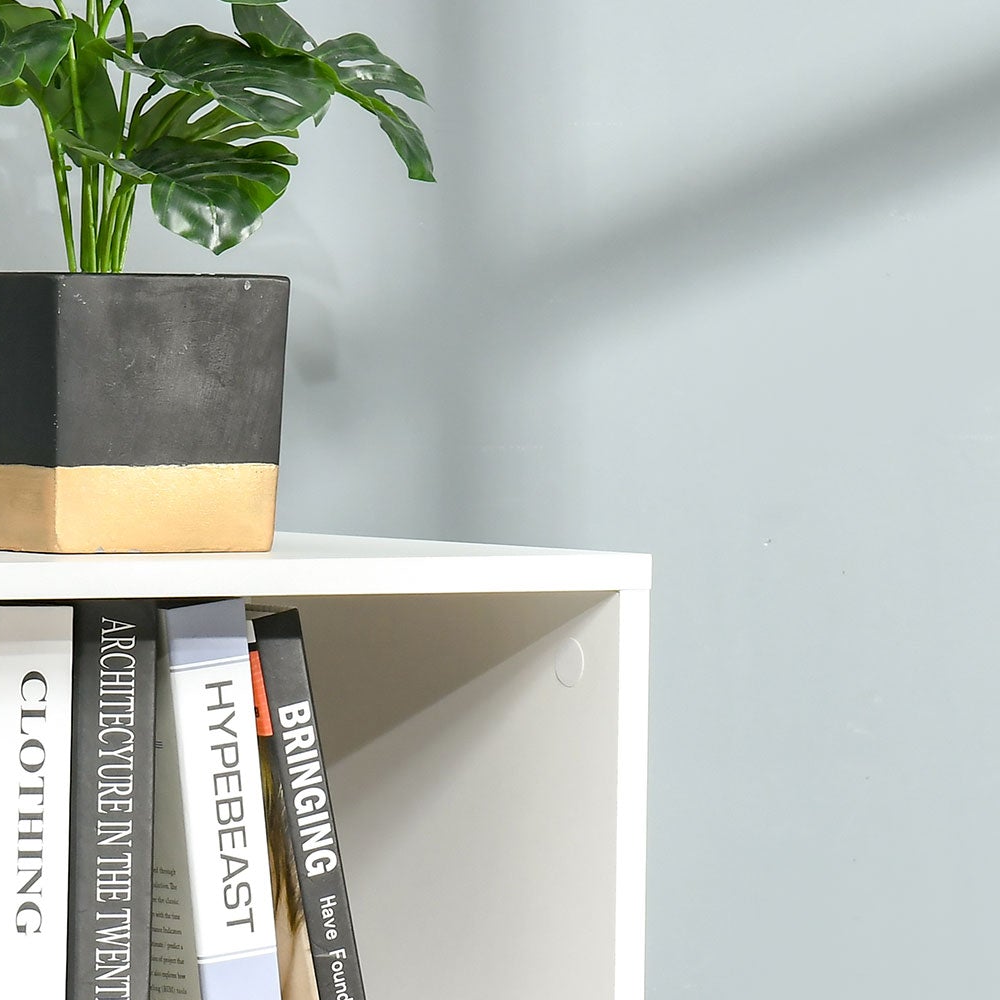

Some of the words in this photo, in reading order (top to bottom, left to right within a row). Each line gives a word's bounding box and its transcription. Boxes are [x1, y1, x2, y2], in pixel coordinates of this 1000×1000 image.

[16, 671, 48, 935] CLOTHING
[97, 617, 136, 814] ARCHITECYURE
[278, 700, 337, 877] BRINGING
[96, 853, 131, 903] THE
[97, 820, 132, 848] IN
[205, 680, 255, 933] HYPEBEAST
[320, 895, 337, 940] Have
